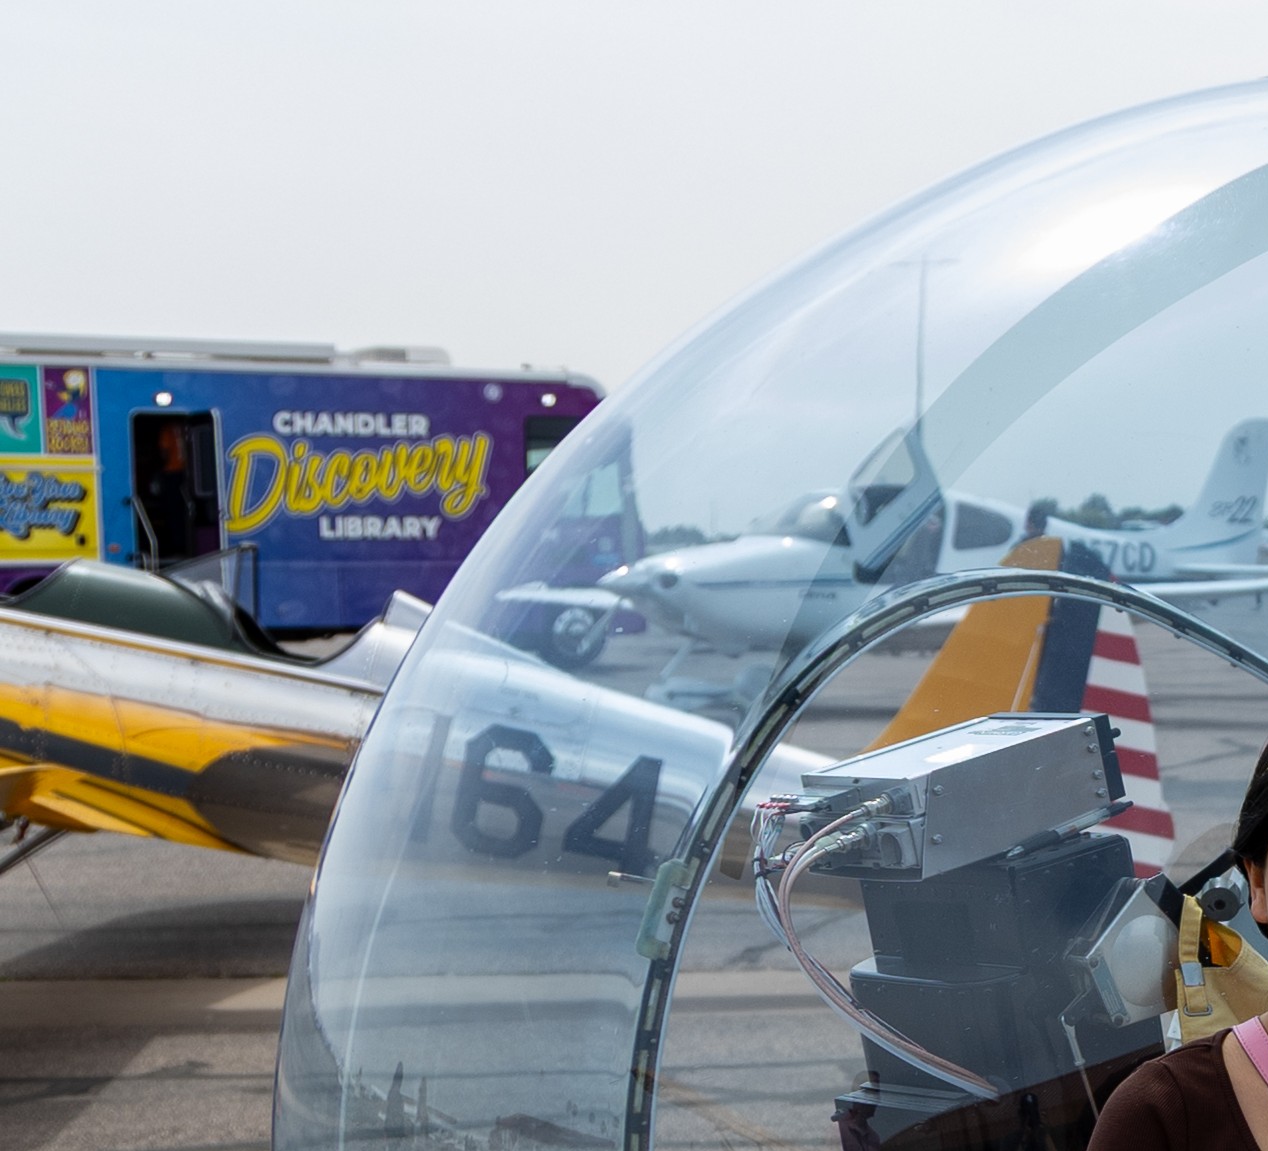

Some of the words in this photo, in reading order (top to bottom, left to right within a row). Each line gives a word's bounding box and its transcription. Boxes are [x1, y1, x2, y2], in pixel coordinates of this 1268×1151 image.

[273, 410, 430, 436] CHANDLER
[224, 432, 491, 533] Discovery
[319, 515, 442, 539] LIBRARY
